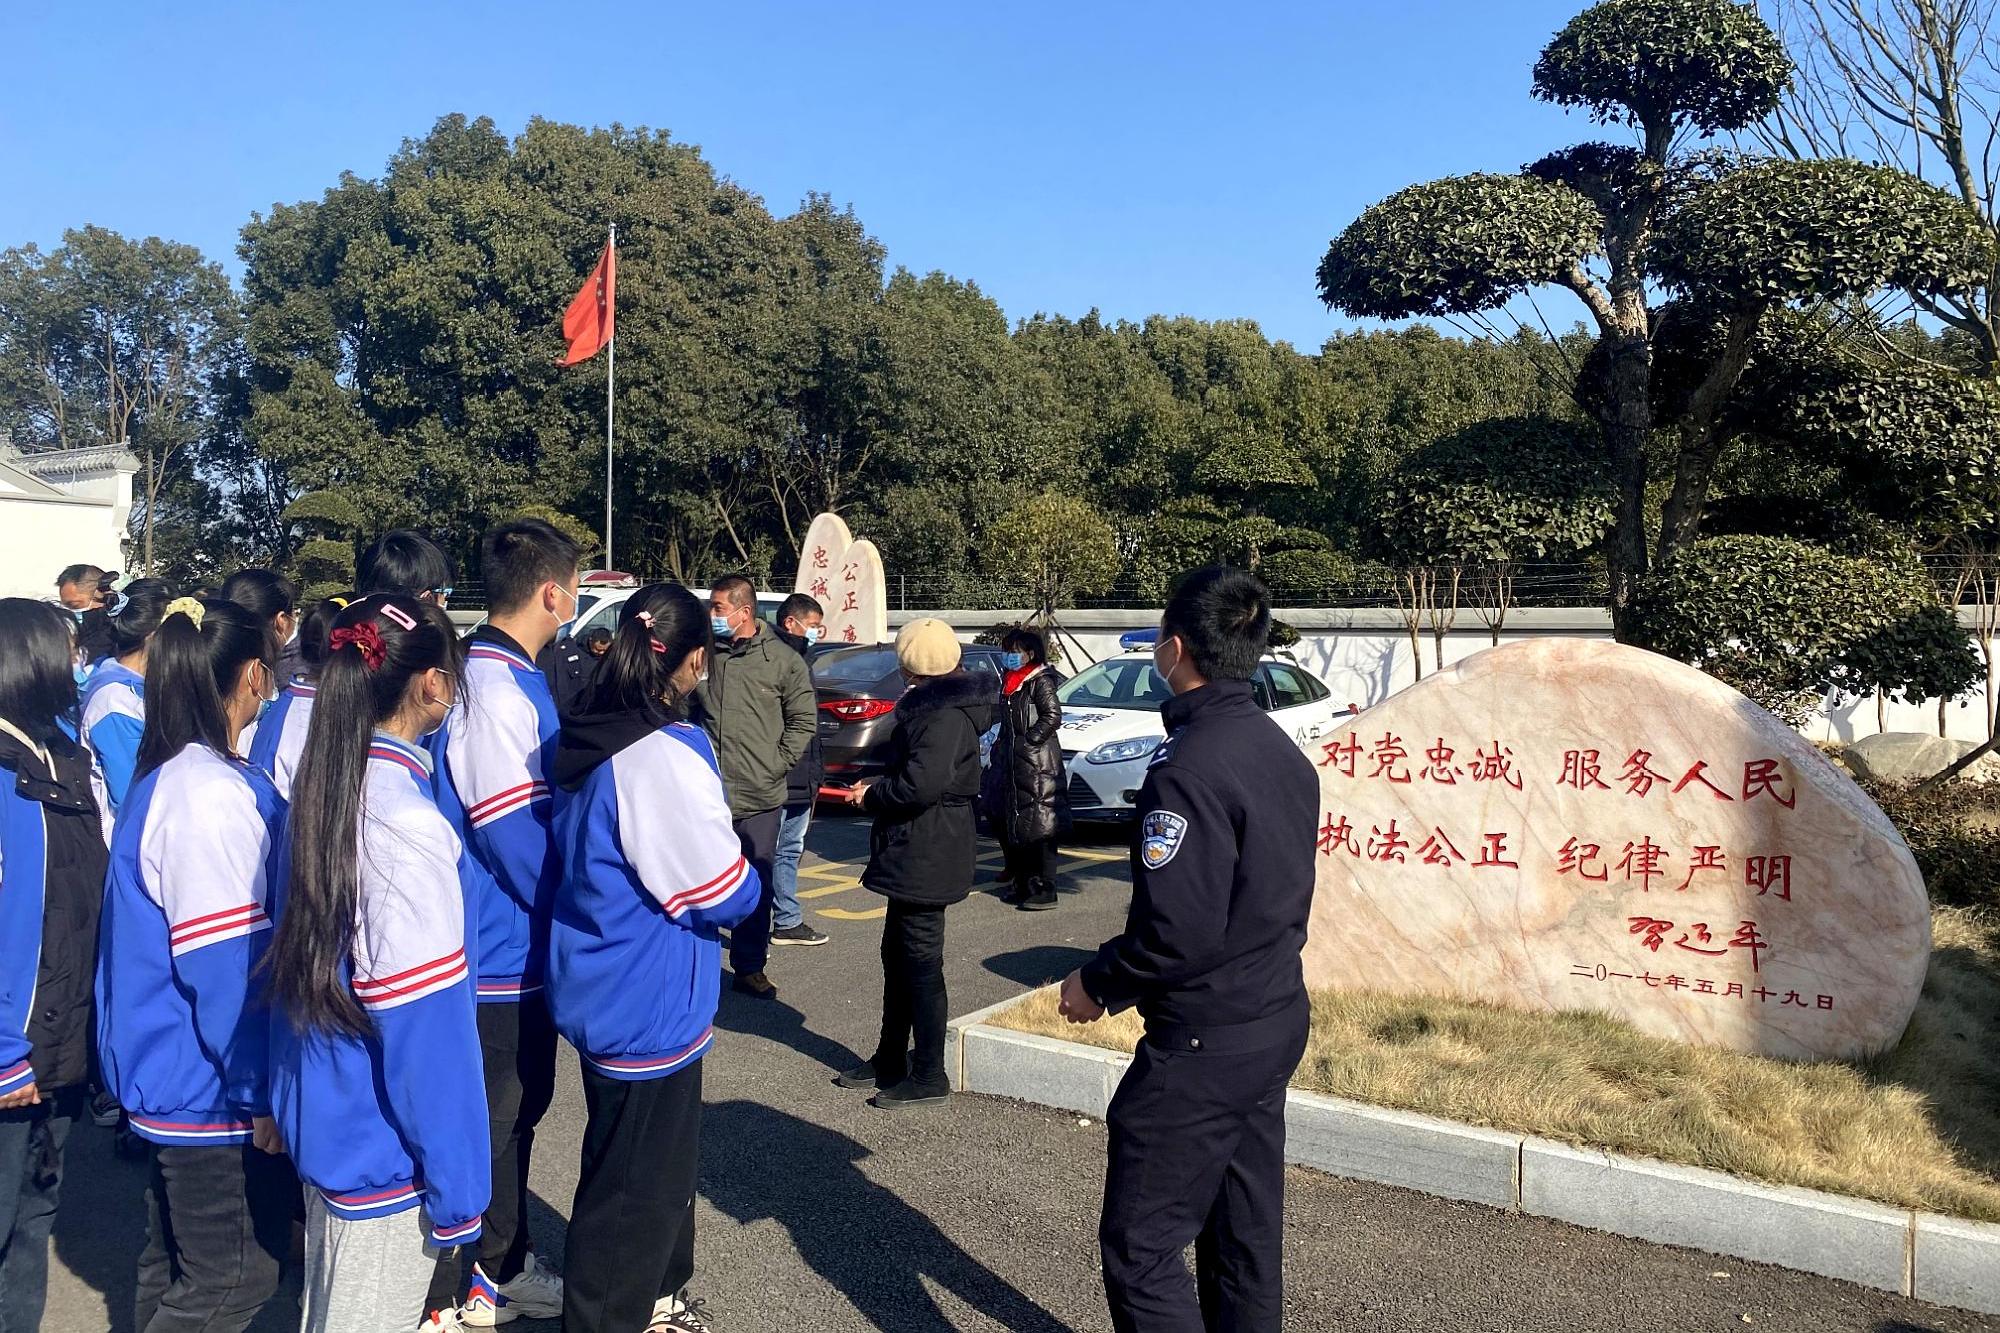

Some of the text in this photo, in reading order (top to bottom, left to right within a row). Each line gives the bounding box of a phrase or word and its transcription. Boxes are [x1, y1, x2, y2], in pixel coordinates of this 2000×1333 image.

[1319, 731, 1797, 811] 对党忠诚 服务人民
[1317, 811, 1794, 901] 执法公正 纪律严明
